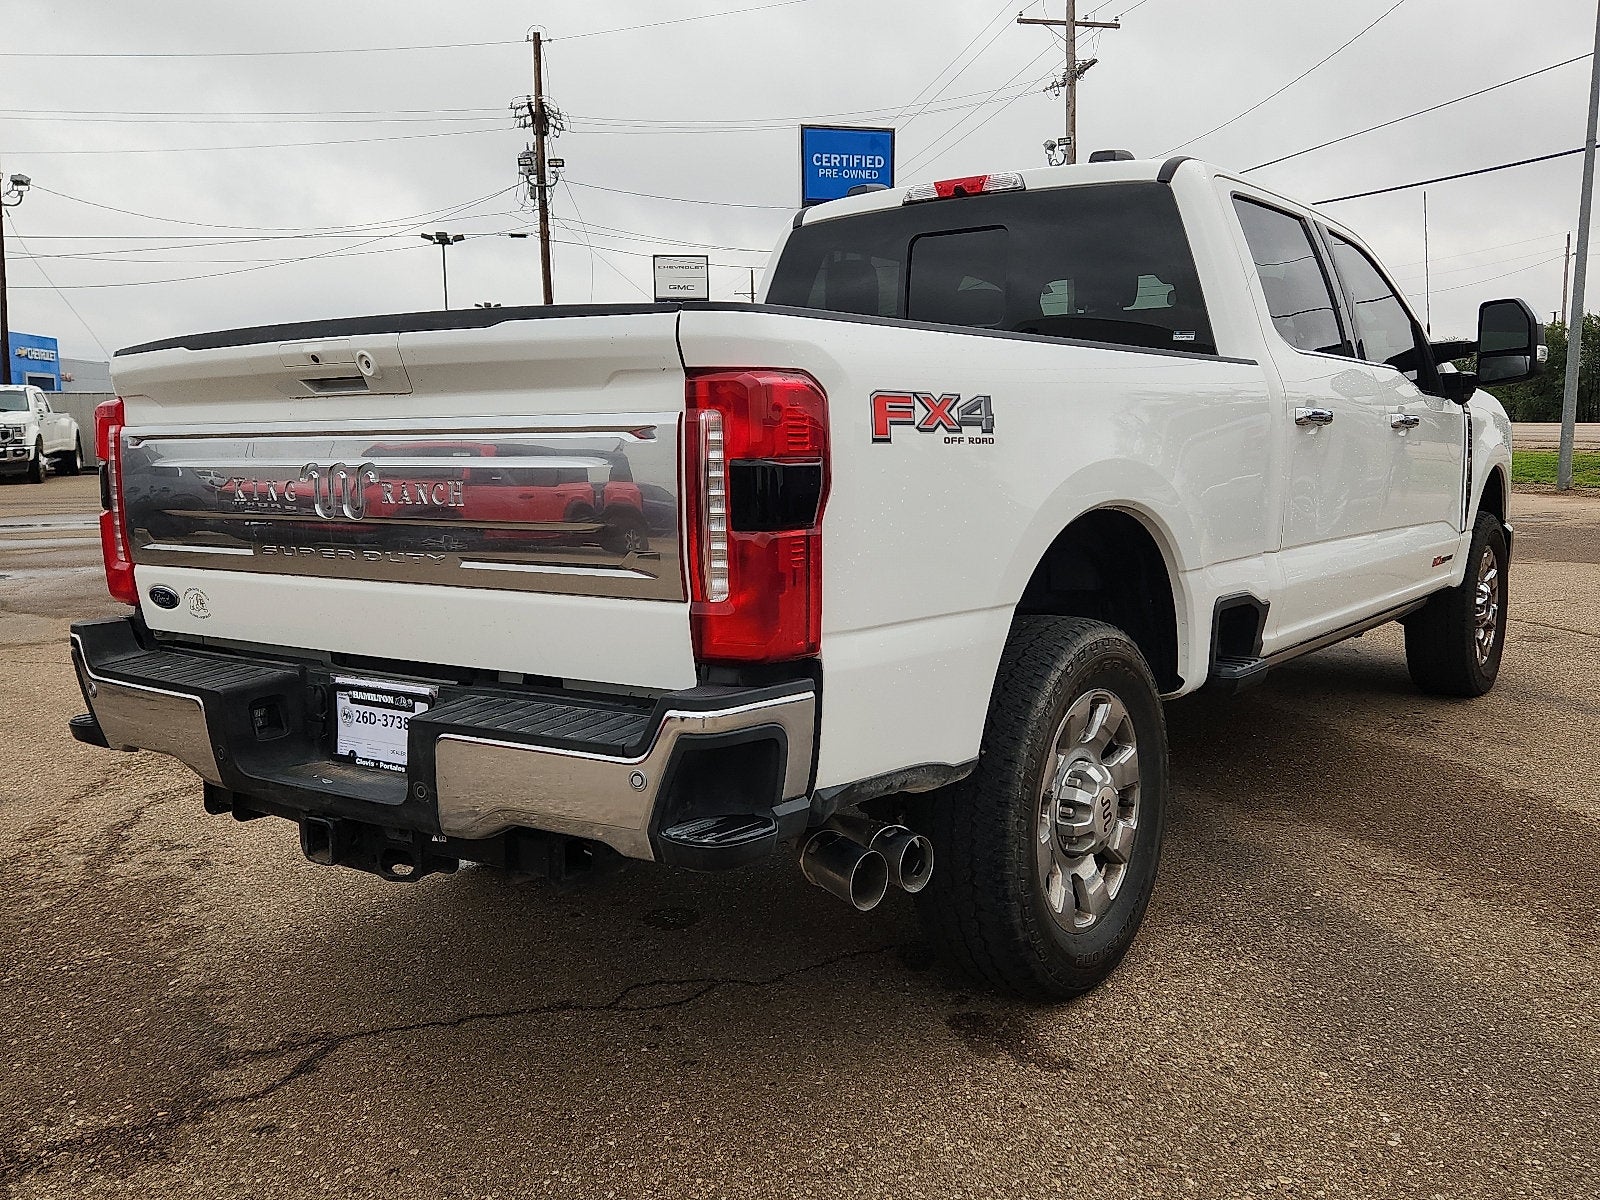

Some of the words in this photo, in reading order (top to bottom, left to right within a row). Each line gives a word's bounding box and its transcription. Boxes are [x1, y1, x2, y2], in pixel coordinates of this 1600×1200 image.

[812, 153, 885, 168] CERTIFIED
[818, 168, 879, 179] PRE-OWNED
[869, 390, 995, 444] FX4
[943, 436, 965, 445] OFF
[968, 436, 995, 445] ROAD
[232, 477, 297, 502] KING
[381, 480, 465, 507] RANCH
[261, 545, 356, 560] SUPER
[363, 550, 446, 566] DUTY
[355, 758, 375, 767] Clovis
